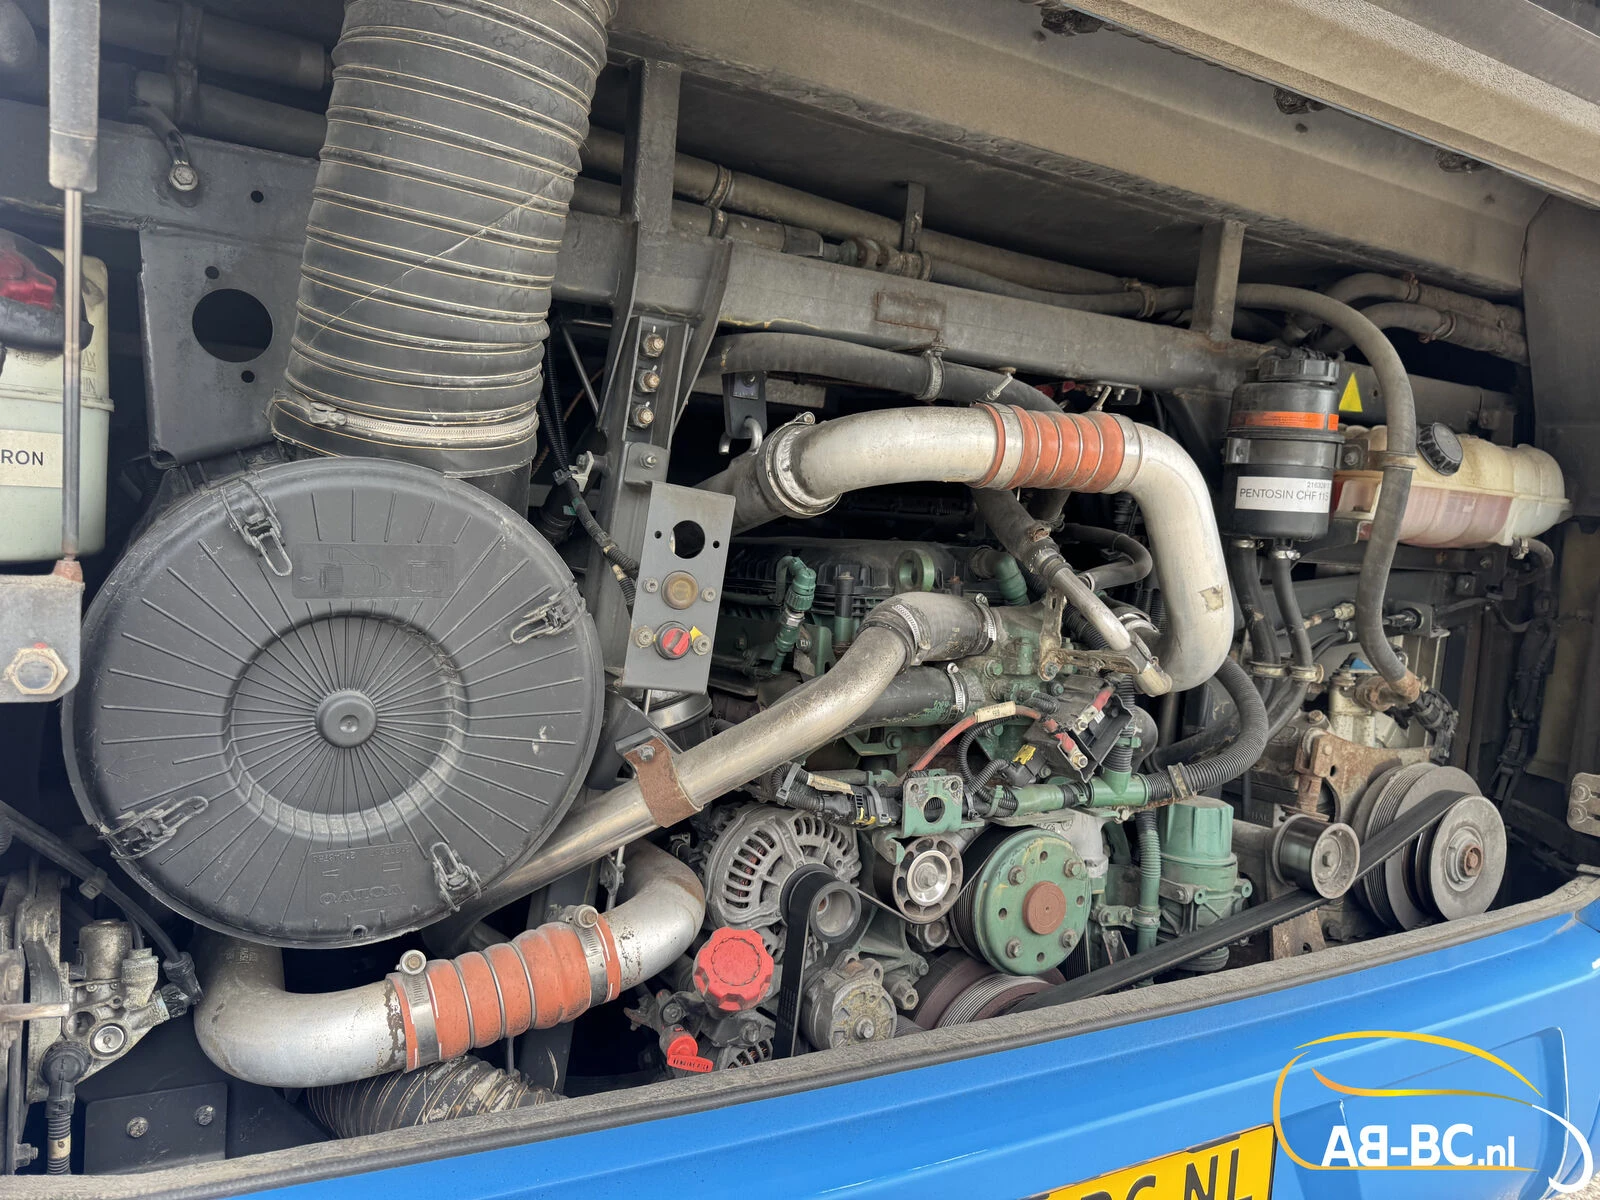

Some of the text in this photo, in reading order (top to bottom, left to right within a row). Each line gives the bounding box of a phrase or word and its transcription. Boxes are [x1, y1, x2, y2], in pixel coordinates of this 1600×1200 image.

[0, 449, 44, 466] RON
[1240, 488, 1294, 500] PENTOSIN
[1295, 490, 1317, 501] CHF
